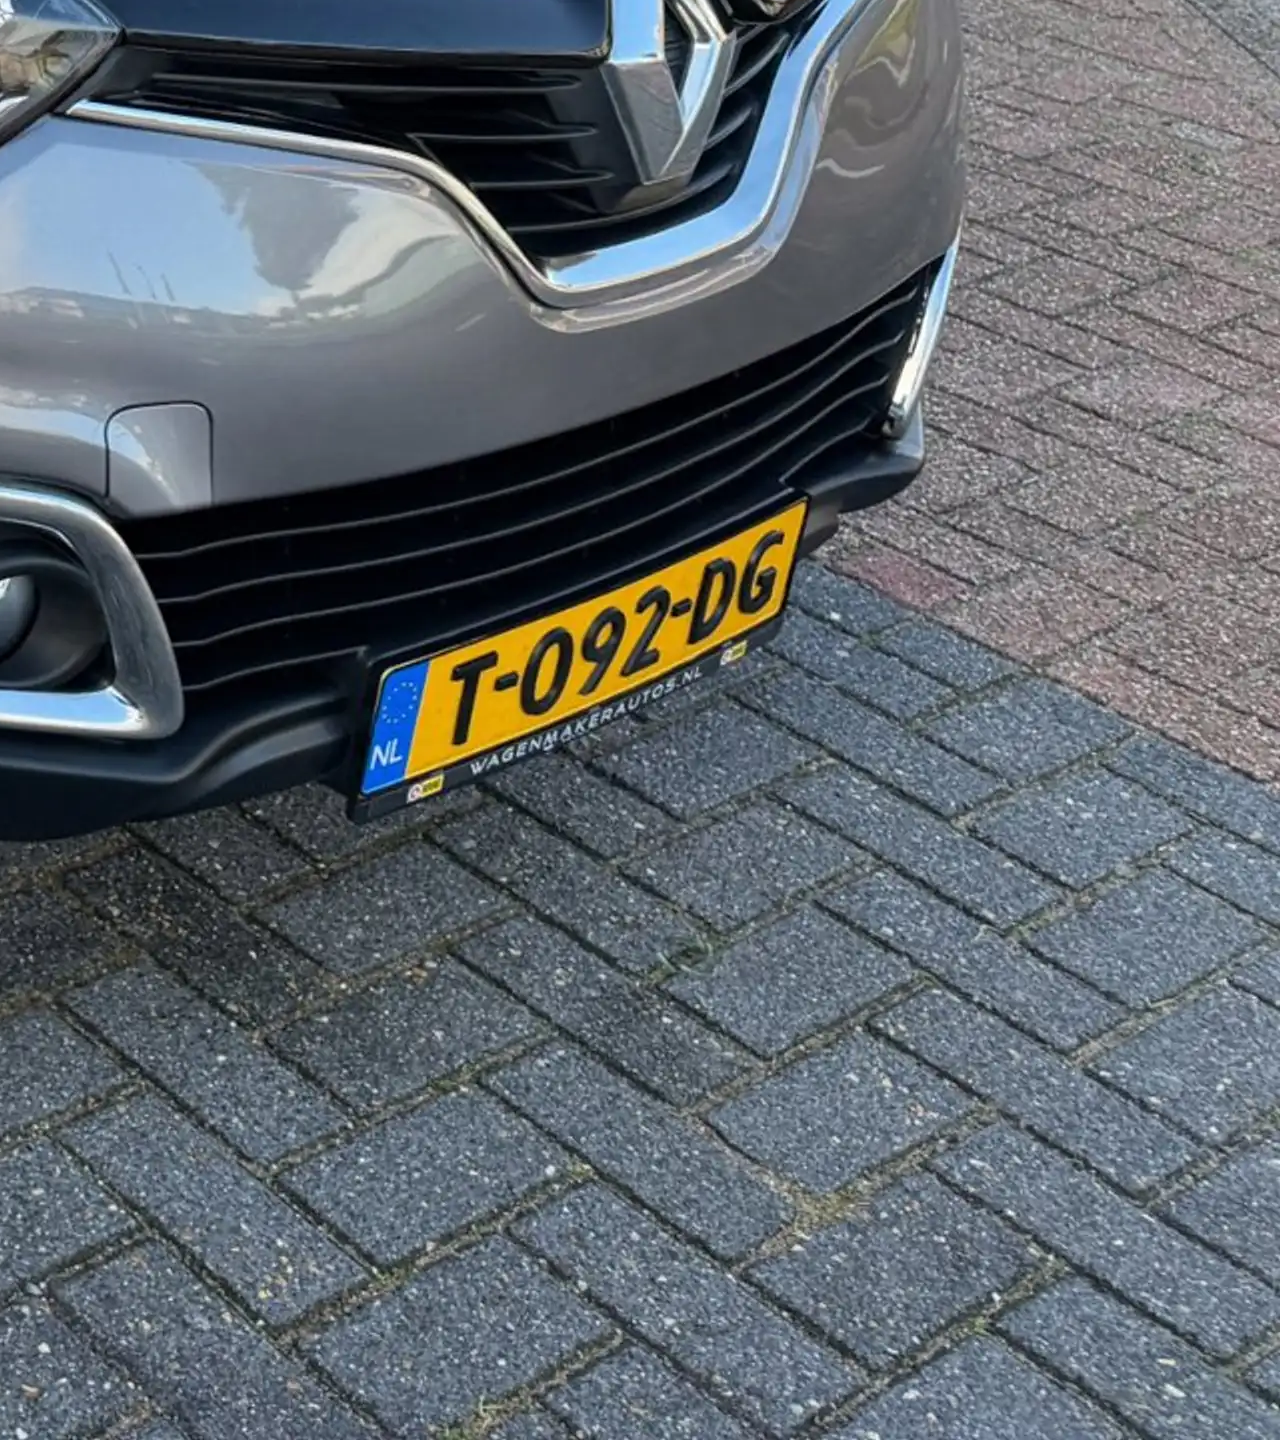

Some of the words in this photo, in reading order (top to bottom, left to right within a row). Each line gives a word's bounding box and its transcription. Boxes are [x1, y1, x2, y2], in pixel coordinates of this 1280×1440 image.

[450, 529, 785, 747] T-092-DG
[370, 738, 403, 771] NL
[469, 665, 704, 776] WAGENMAKERAUTOS.NL
